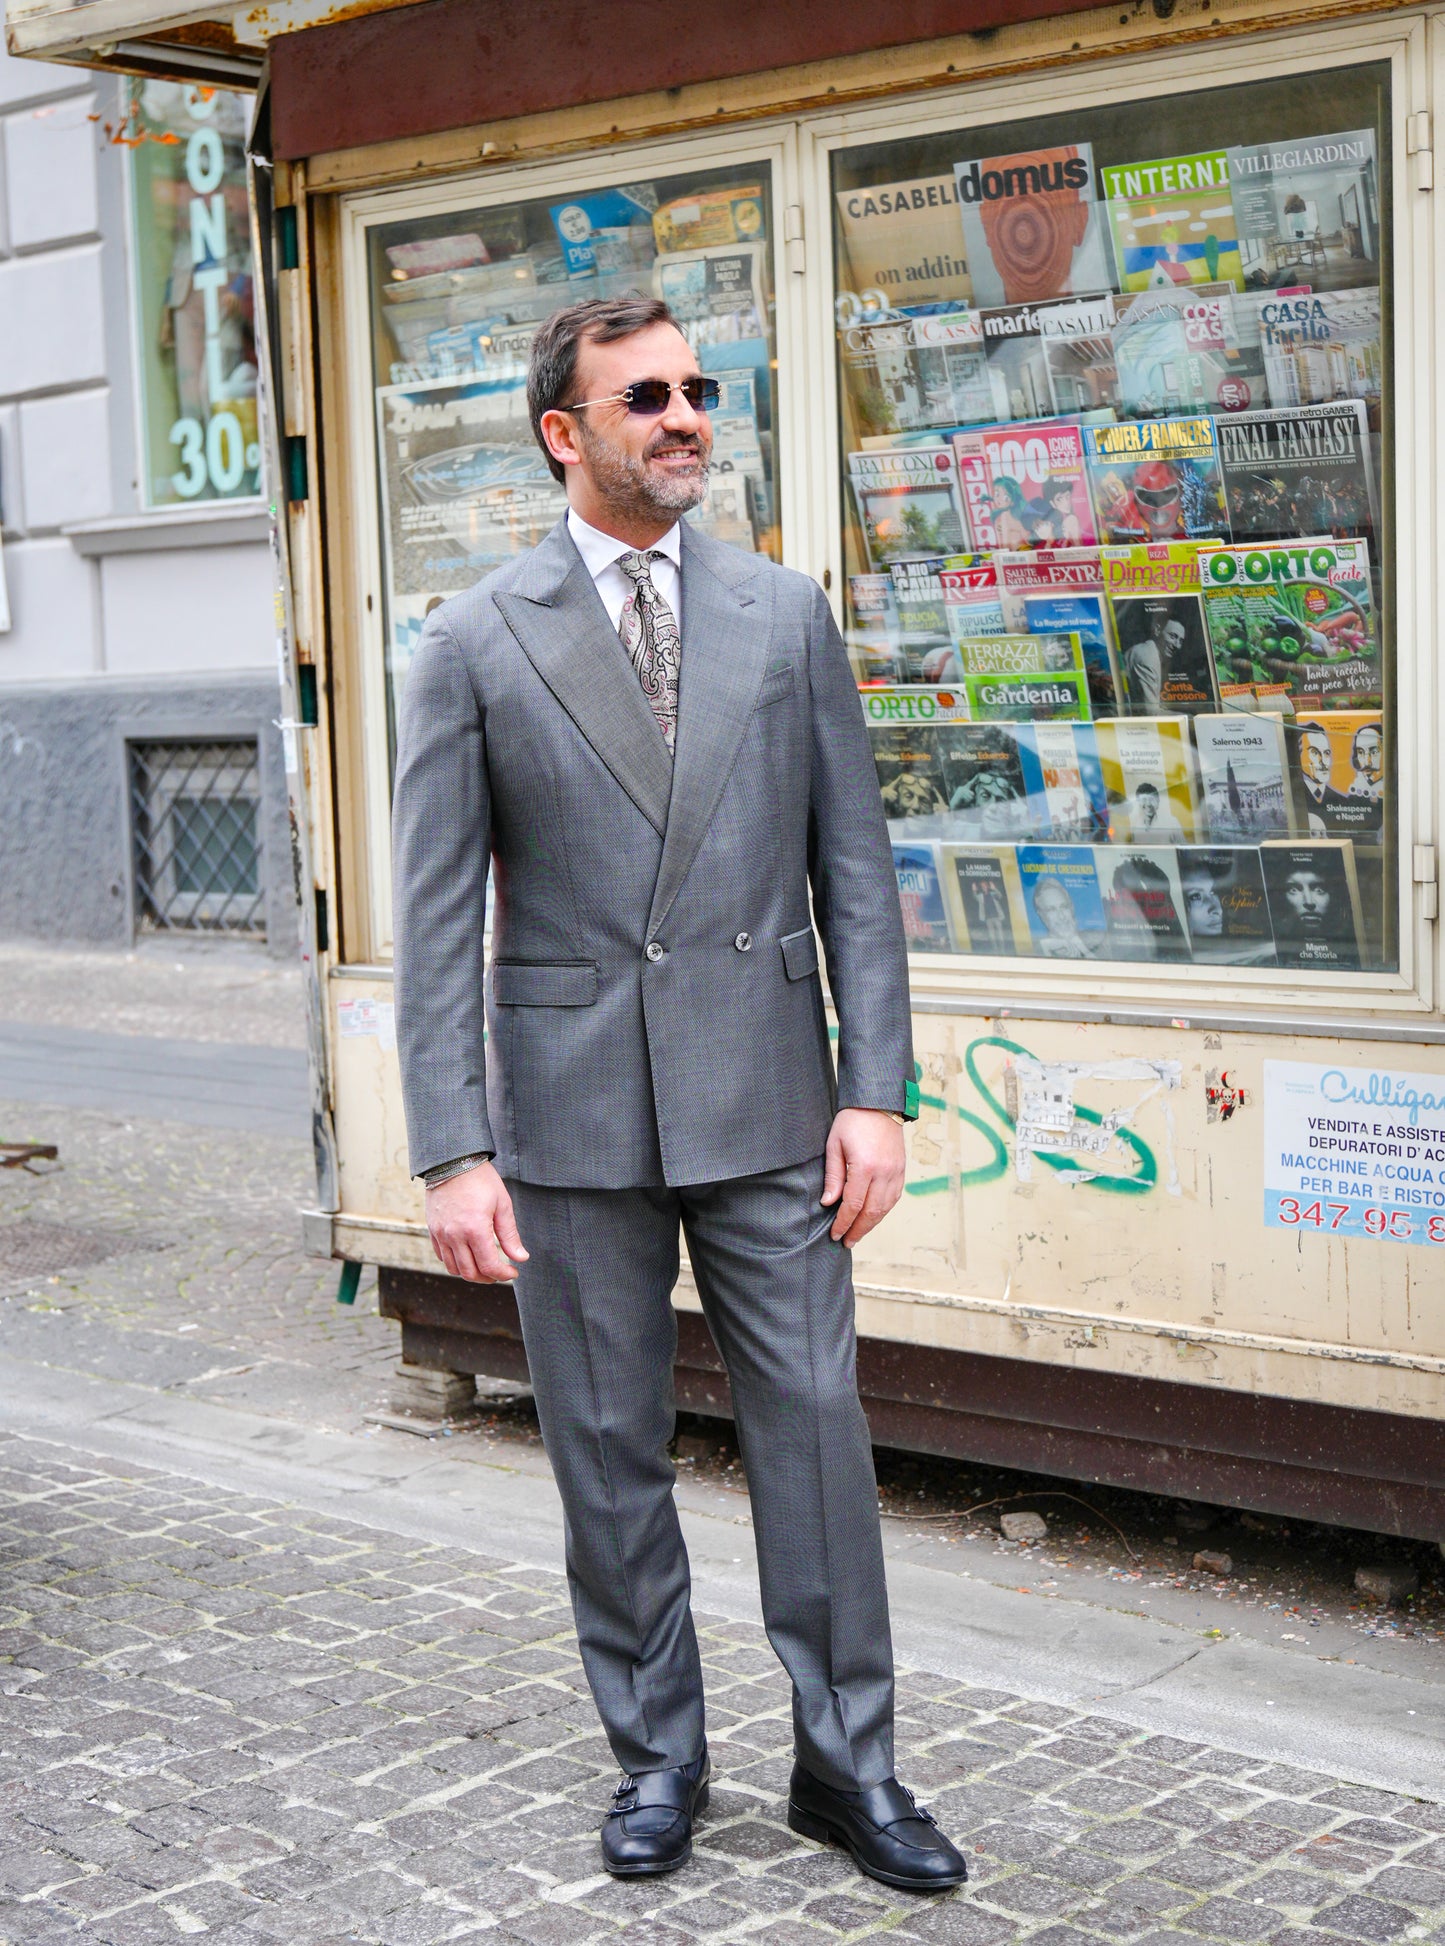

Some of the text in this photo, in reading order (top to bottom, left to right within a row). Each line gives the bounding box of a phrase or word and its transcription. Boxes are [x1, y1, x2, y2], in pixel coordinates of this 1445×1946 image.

[1234, 141, 1366, 175] VILLEGIARDINI
[960, 158, 1089, 203] domus
[1110, 158, 1230, 198] INTERNI
[875, 267, 901, 286] on
[984, 307, 1040, 336] marie
[1261, 300, 1328, 325] CASA
[1300, 407, 1322, 417] retro
[1322, 406, 1354, 416] GAMER
[1048, 436, 1076, 451] ICONE
[1093, 425, 1141, 453] POWER
[1150, 419, 1213, 450] RANGERS
[1220, 417, 1356, 462] FINAL FANTASY
[857, 454, 934, 475] BALCONI
[985, 438, 1050, 484] 100
[1149, 550, 1169, 559] RIZA
[906, 563, 929, 577] MIO
[1005, 568, 1037, 578] SALUTE
[1244, 547, 1337, 582] ORTO
[1327, 564, 1363, 587] facile
[943, 572, 996, 601] RIZ
[963, 642, 1038, 660] TERRAZZI
[1306, 661, 1372, 681] Tanto raccolto
[1163, 681, 1193, 692] Canta
[1304, 675, 1378, 693] con poco sforzo
[981, 684, 1073, 705] Gardenia
[1161, 690, 1207, 701] Carosone
[868, 695, 936, 719] ORTO
[1212, 737, 1263, 746] Salerno 1943
[1326, 803, 1372, 815] Shakespeare
[1341, 812, 1365, 823] Napoli
[1299, 951, 1338, 960] che Storia
[1306, 943, 1328, 951] Mann
[1307, 1117, 1369, 1135] VENDITA
[1373, 1124, 1382, 1136] E
[1309, 1136, 1402, 1158] DEPURATORI
[1281, 1153, 1368, 1176] MACCHINE
[1373, 1163, 1435, 1183] ACQUA
[1300, 1176, 1333, 1193] PER
[1338, 1181, 1373, 1198] BAR
[1379, 1185, 1389, 1200] E
[1278, 1198, 1350, 1229] 347
[1364, 1208, 1413, 1238] 95
